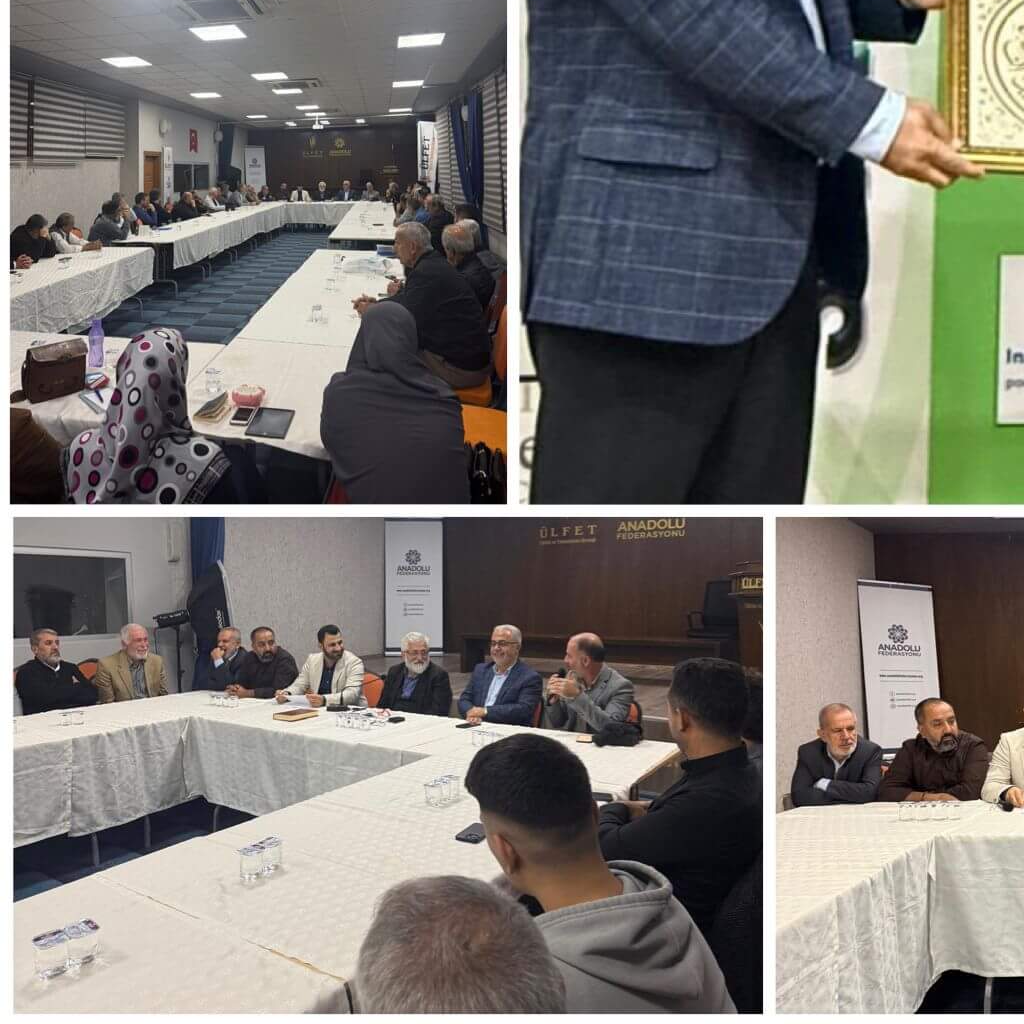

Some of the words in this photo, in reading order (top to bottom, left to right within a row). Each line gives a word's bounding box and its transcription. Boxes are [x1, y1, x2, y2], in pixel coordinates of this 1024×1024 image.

[617, 518, 685, 532] ANADOLU
[540, 525, 597, 538] ÜLFET
[616, 530, 685, 540] FEDERASYONU
[878, 643, 921, 652] ANADOLU
